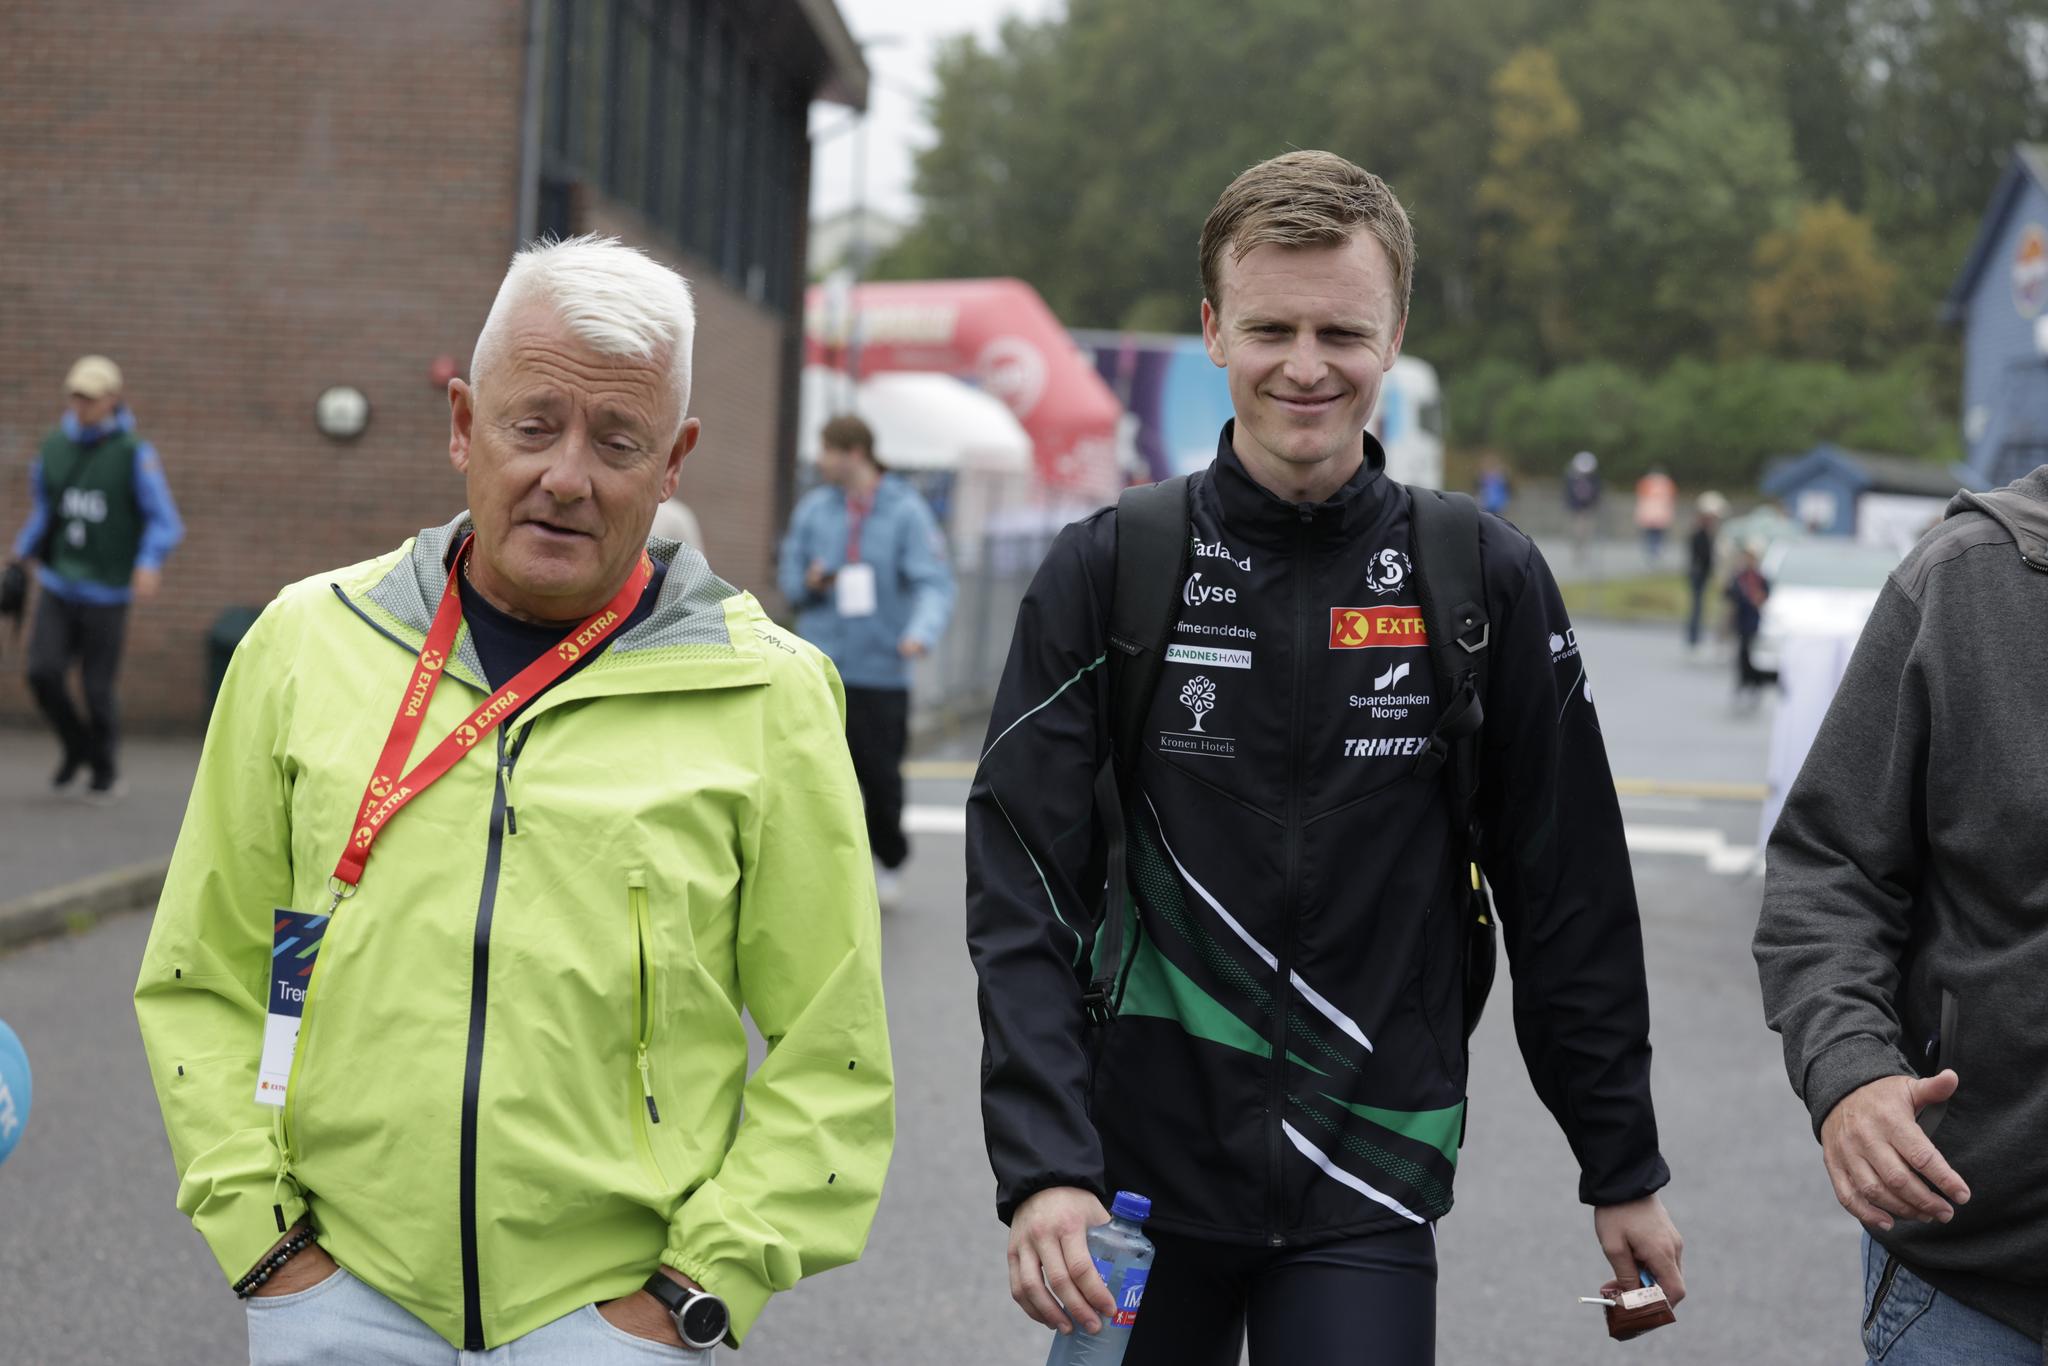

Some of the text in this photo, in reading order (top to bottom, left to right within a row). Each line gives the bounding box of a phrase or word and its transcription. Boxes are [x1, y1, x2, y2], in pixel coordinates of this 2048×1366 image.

[1188, 579, 1237, 604] Lyse
[576, 610, 618, 647] EXTRA
[1376, 617, 1427, 635] EXTR
[405, 672, 432, 717] EXTRA
[1349, 693, 1430, 708] Sparebanken
[474, 690, 519, 729] EXTRA
[1371, 707, 1409, 720] Norge
[1161, 736, 1235, 752] Kronen Hotels
[1344, 737, 1428, 757] TRIMTEX
[370, 786, 412, 826] EXTRA
